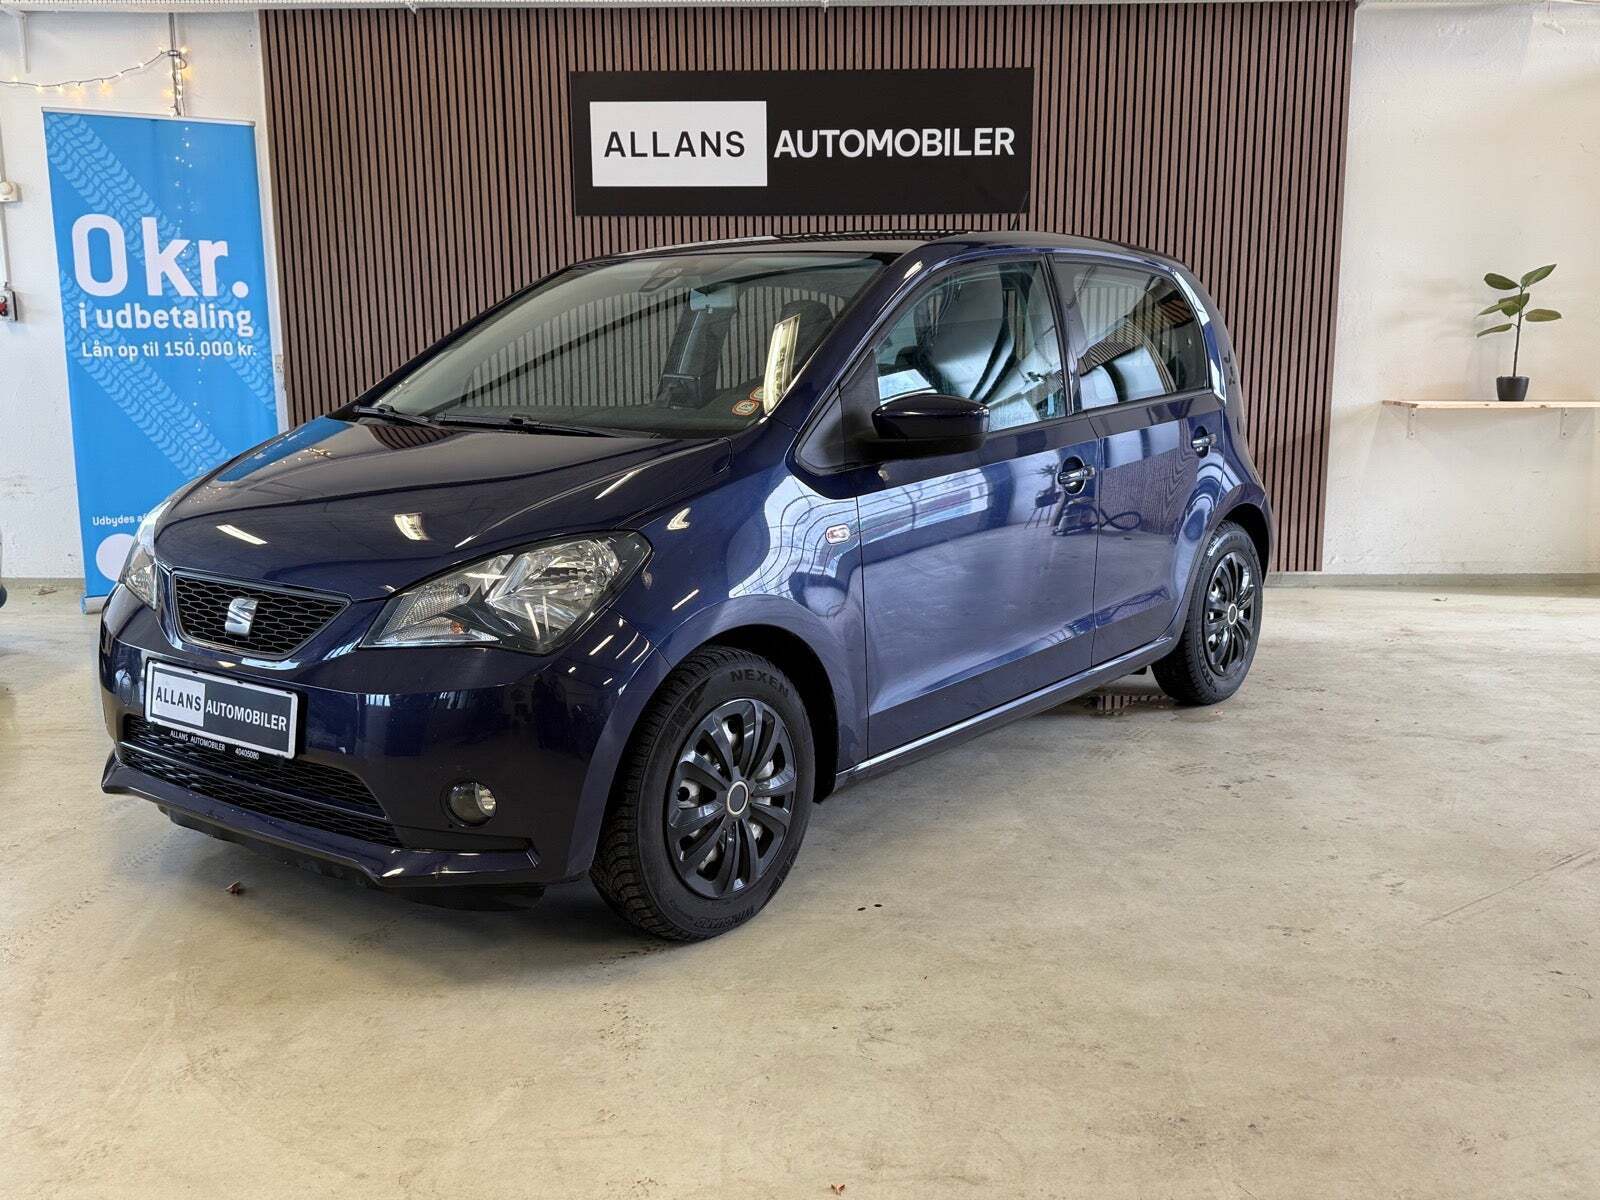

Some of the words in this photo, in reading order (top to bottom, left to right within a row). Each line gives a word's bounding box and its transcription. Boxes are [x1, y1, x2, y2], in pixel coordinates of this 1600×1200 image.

[603, 131, 745, 158] ALLANS
[773, 127, 1015, 158] AUTOMOBILER
[71, 213, 128, 297] 0
[141, 217, 249, 298] kr.
[78, 302, 88, 329] i
[96, 302, 254, 337] udbetaling
[81, 340, 113, 358] Lån
[118, 344, 138, 361] op
[142, 341, 159, 357] til
[165, 341, 233, 357] 150.000
[237, 342, 257, 357] kr.
[92, 514, 134, 527] Udbydes
[730, 669, 789, 697] NEXEN
[155, 686, 201, 711] ALLANS
[205, 699, 287, 732] AUTOMOBILER
[169, 730, 188, 741] ALLANS
[190, 735, 226, 751] AUTOMOBILER
